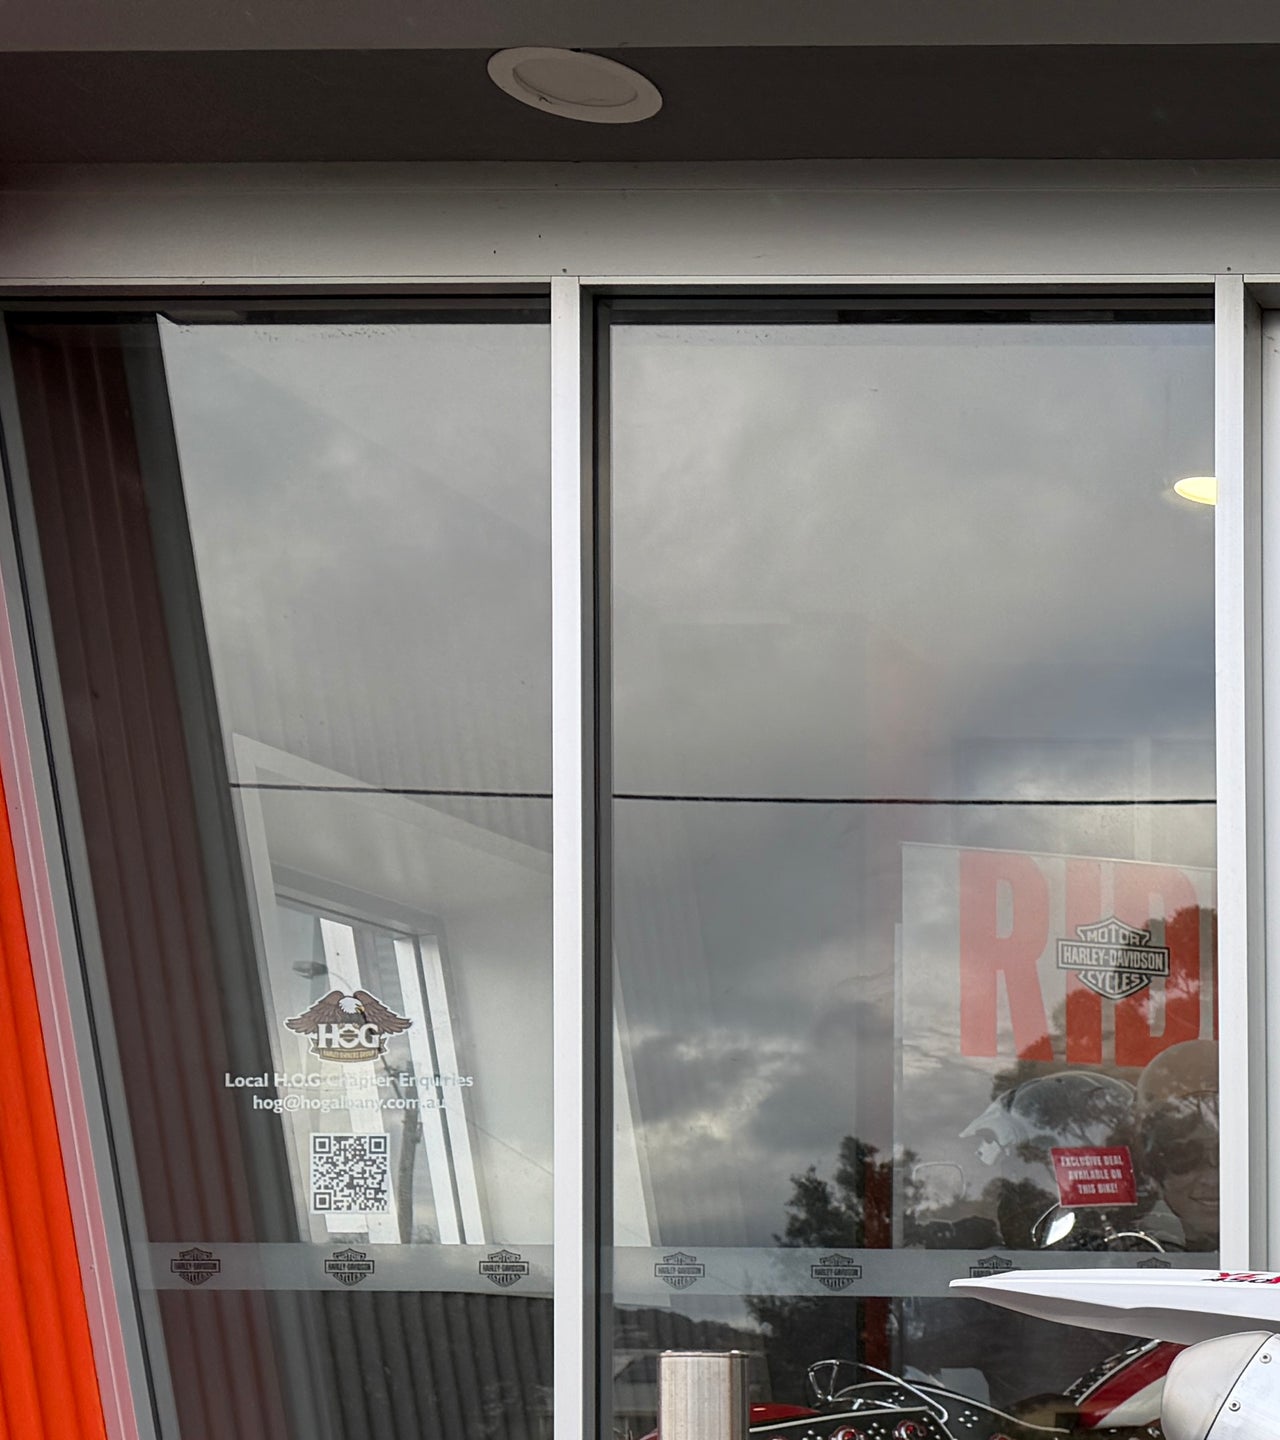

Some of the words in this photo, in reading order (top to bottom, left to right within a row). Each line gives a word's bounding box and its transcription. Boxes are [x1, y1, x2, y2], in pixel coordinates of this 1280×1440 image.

[1086, 924, 1141, 946] MOTOR
[960, 850, 1217, 1068] RID
[1063, 945, 1163, 970] HARLEY-DAVIDSON
[1087, 970, 1141, 993] CYCLES
[317, 1023, 380, 1048] HOG
[225, 1072, 268, 1088] Local
[274, 1073, 321, 1088] H.O.G
[325, 1073, 393, 1091] Chapter
